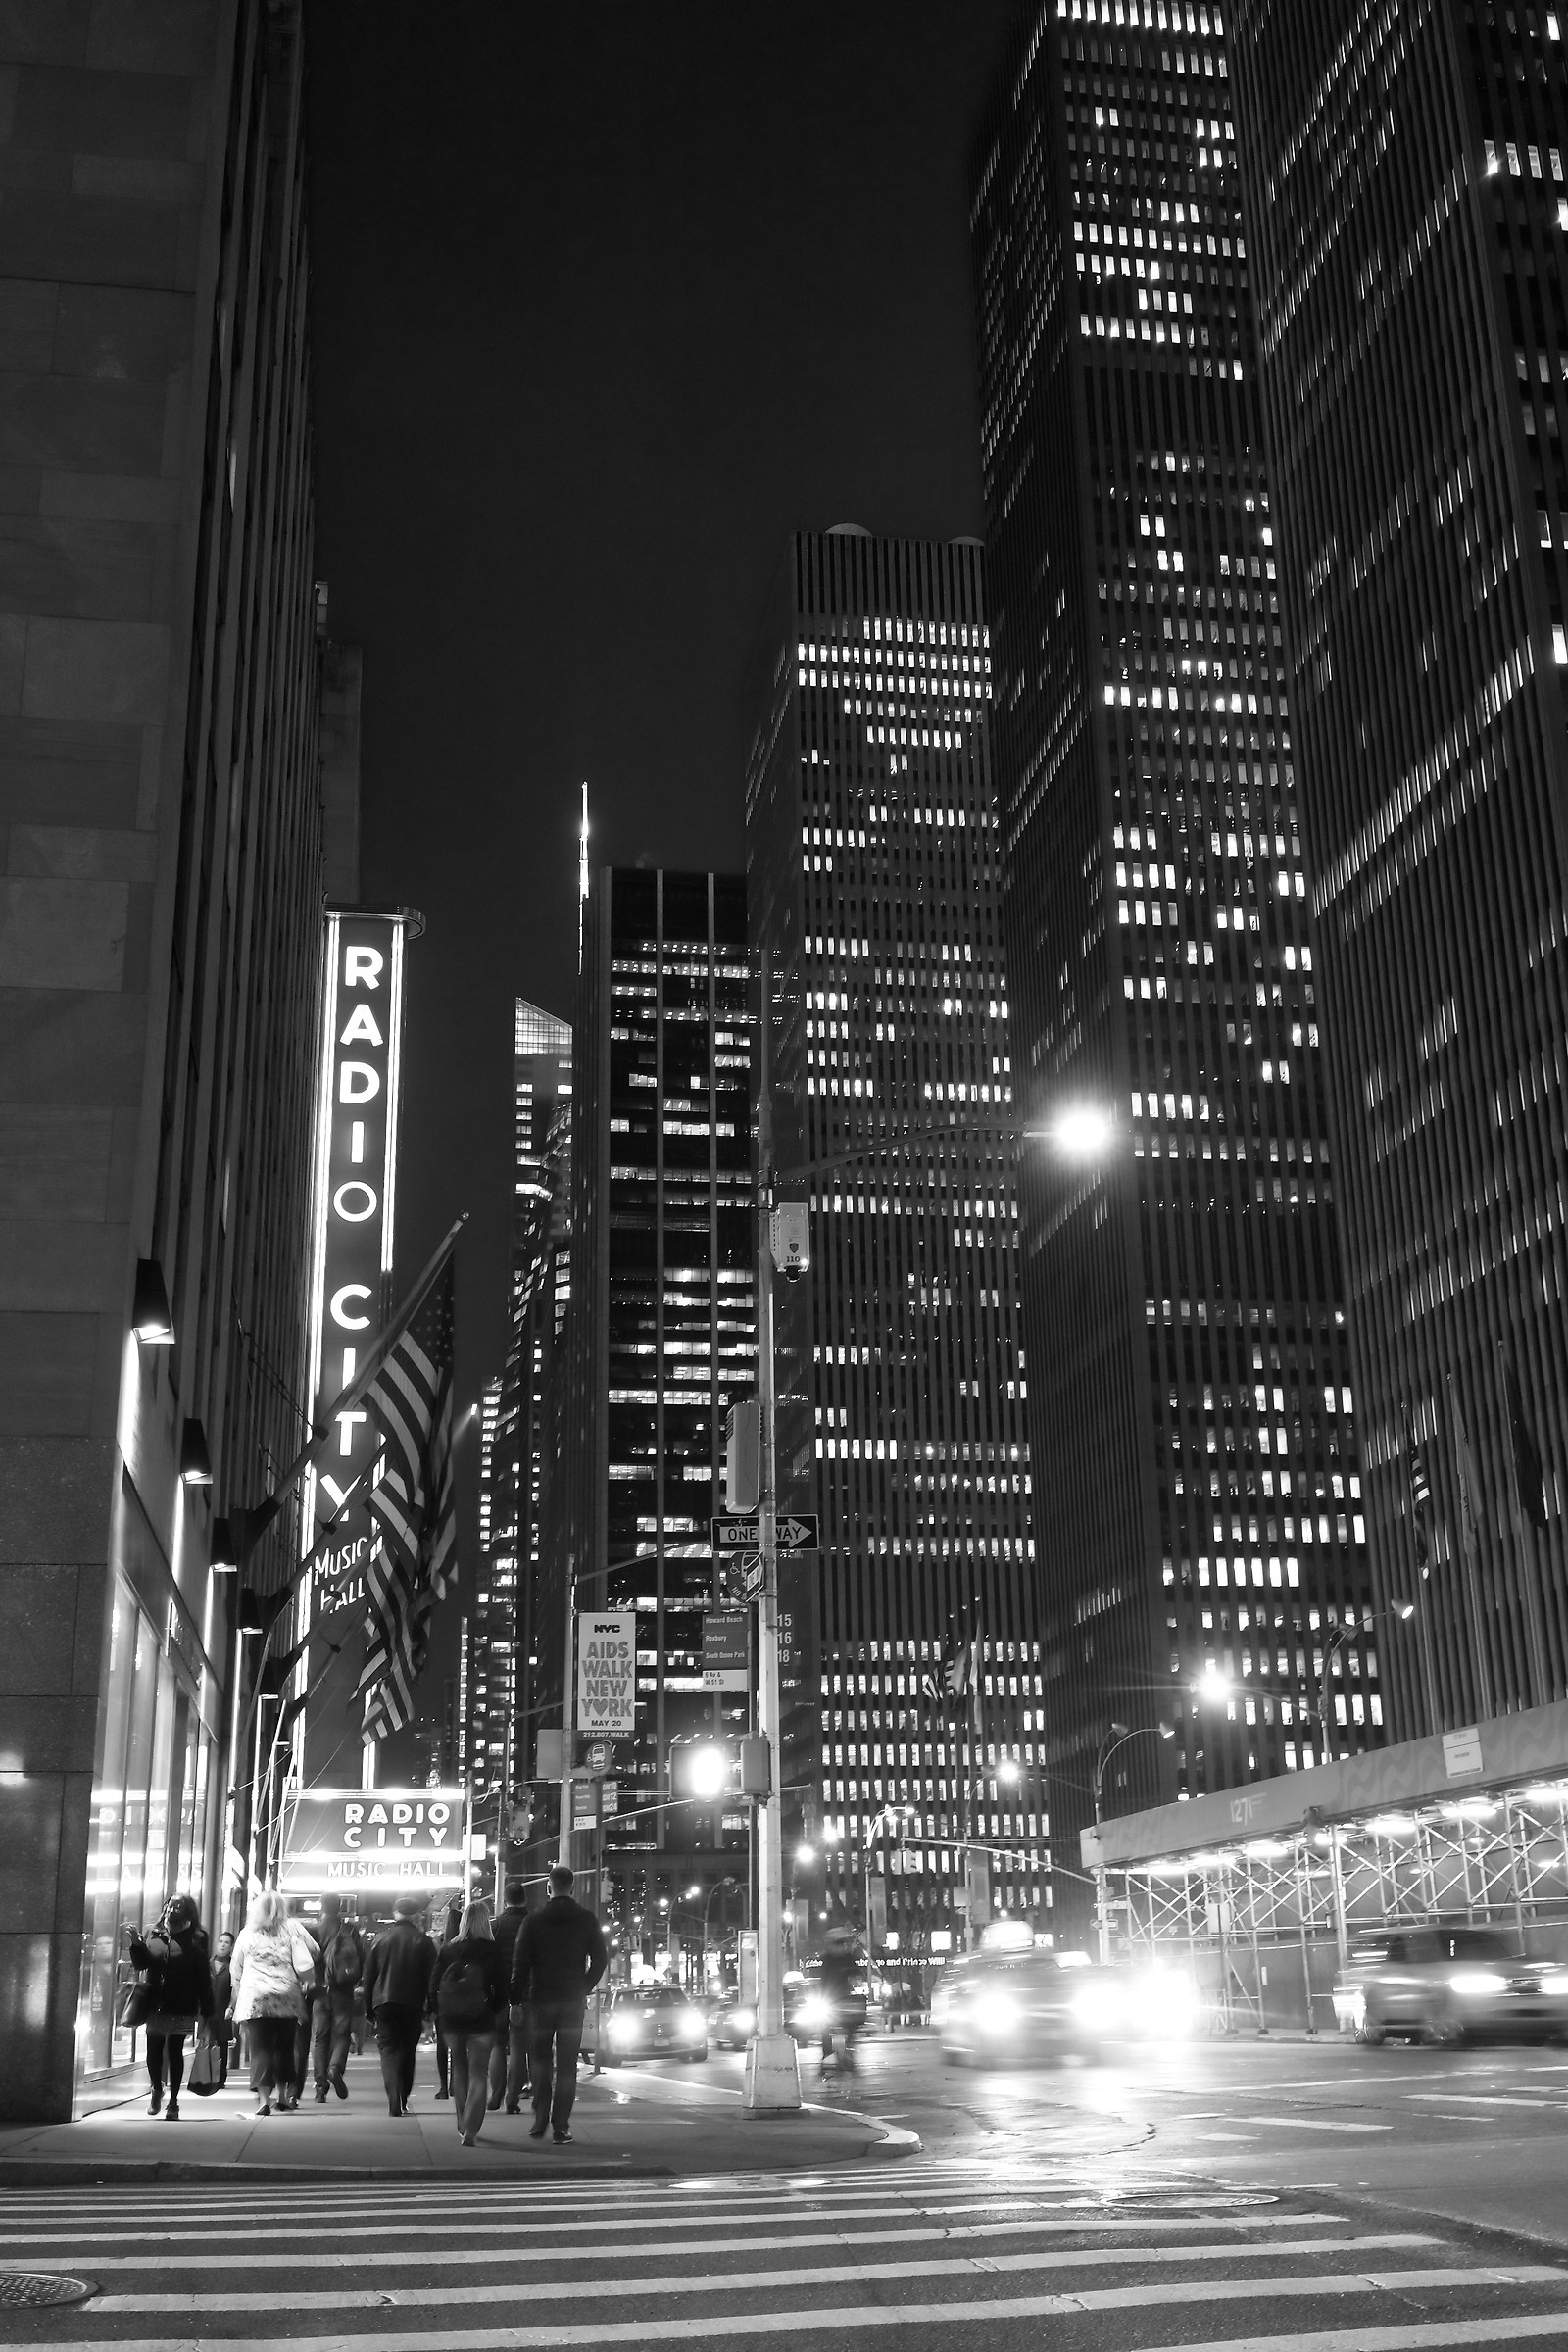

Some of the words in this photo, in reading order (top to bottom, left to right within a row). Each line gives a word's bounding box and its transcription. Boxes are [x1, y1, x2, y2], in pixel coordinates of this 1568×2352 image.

[333, 946, 383, 1222] RADIO
[320, 1284, 372, 1521] CITY
[728, 1528, 758, 1541] ONE
[315, 1537, 368, 1585] MUSIC
[594, 1624, 620, 1633] NYC
[586, 1642, 628, 1658] AIDS
[581, 1660, 632, 1678] WALK
[586, 1680, 627, 1697] NEW
[344, 1802, 450, 1824] RADIO
[1230, 1796, 1252, 1826] 1271
[344, 1827, 447, 1847] CITY
[327, 1862, 385, 1877] MUSIC
[399, 1862, 448, 1877] HALL
